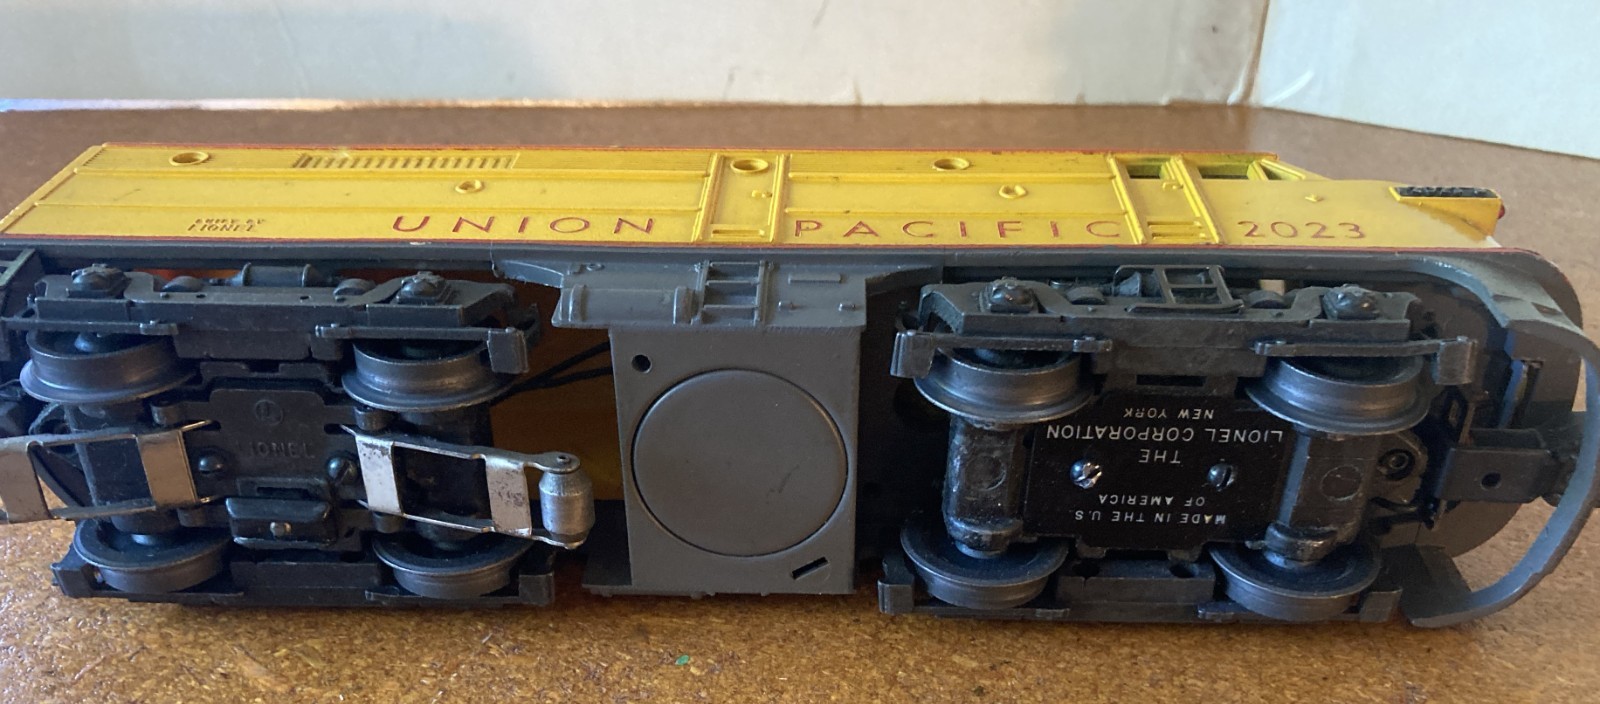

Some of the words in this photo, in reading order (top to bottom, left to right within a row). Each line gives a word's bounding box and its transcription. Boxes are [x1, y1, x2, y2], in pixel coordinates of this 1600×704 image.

[392, 215, 654, 234] UNION
[794, 219, 1120, 239] PACIFIC
[1237, 220, 1366, 239] 2023
[1123, 407, 1167, 419] YORK
[1177, 408, 1214, 420] NEW
[1046, 424, 1194, 442] CORPORATION
[1205, 428, 1283, 443] LIONEL
[1138, 448, 1181, 464] THE
[1098, 494, 1174, 506] AMERICA
[1184, 496, 1205, 507] OF
[1111, 510, 1145, 523] THE
[1153, 512, 1171, 523] IN
[1179, 513, 1226, 525] MADE
